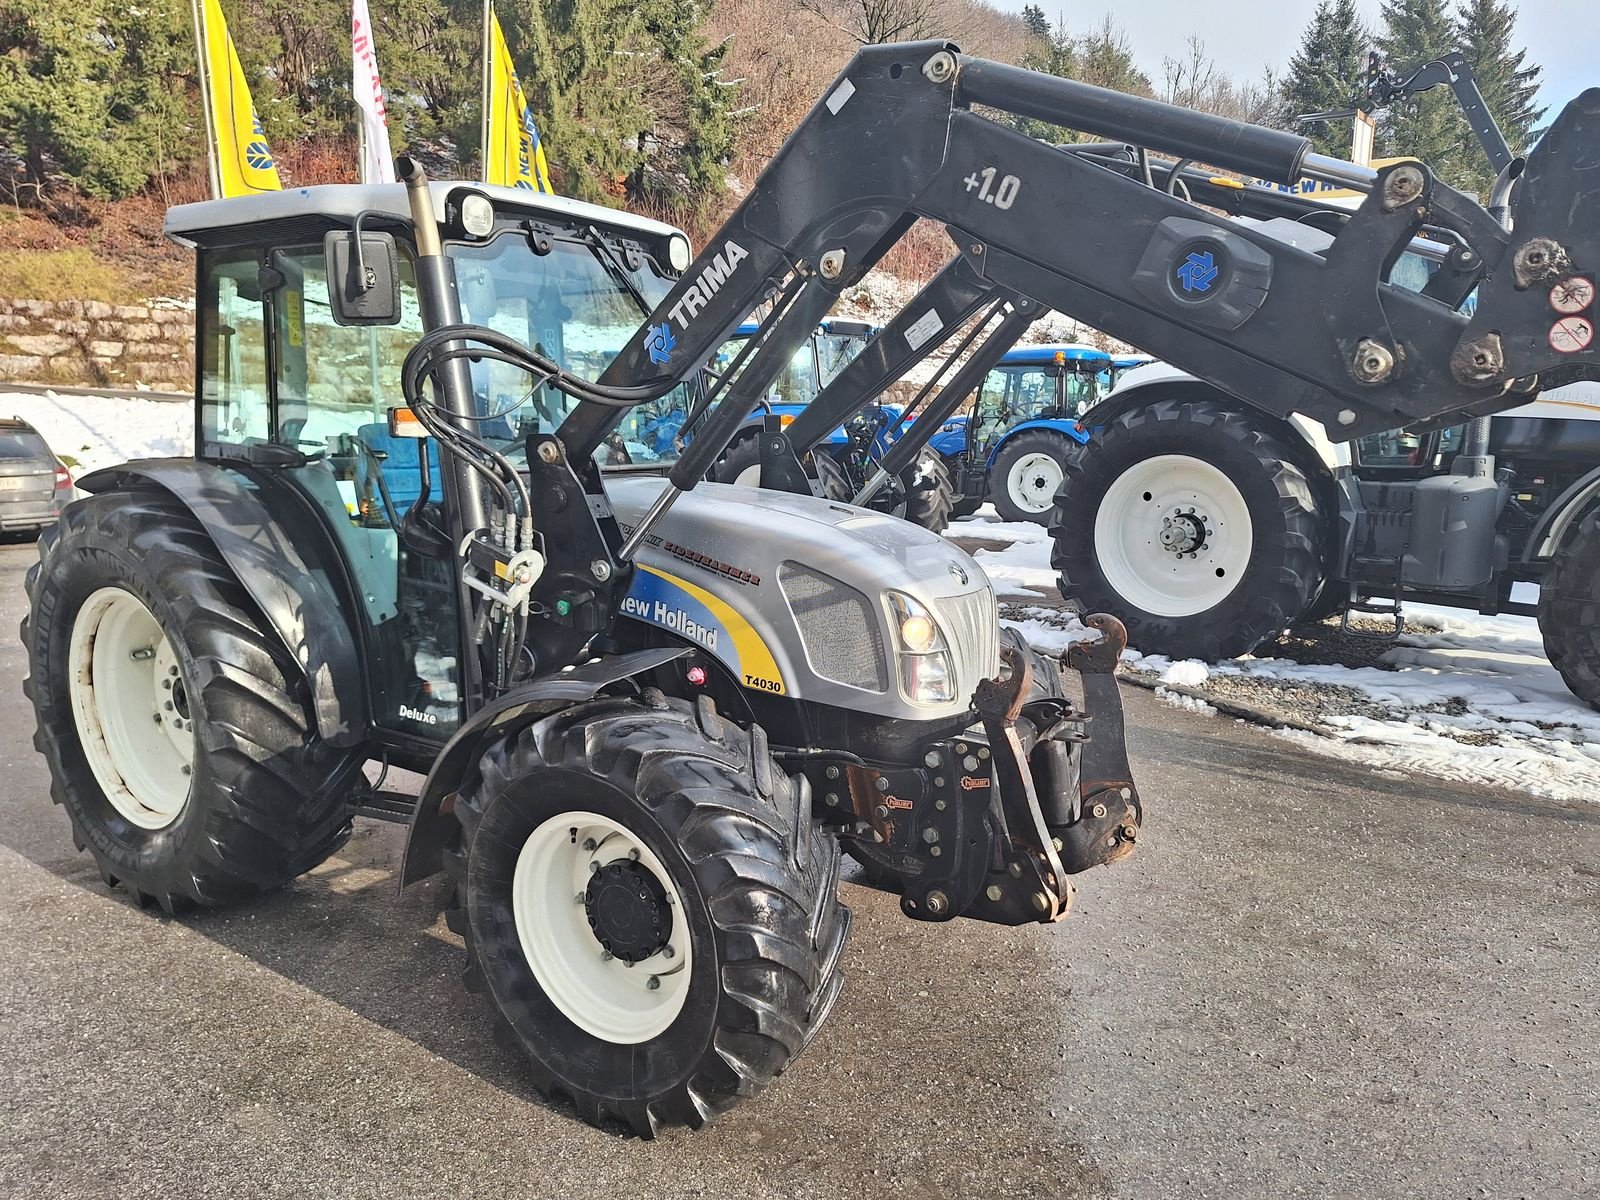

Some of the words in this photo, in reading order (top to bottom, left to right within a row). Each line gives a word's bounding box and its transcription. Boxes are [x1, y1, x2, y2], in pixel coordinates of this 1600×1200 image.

[963, 166, 1021, 211] +1.0
[667, 240, 750, 330] TRIMA
[654, 600, 718, 651] Holland
[745, 674, 781, 693] T4030
[399, 704, 437, 725] Deluxe
